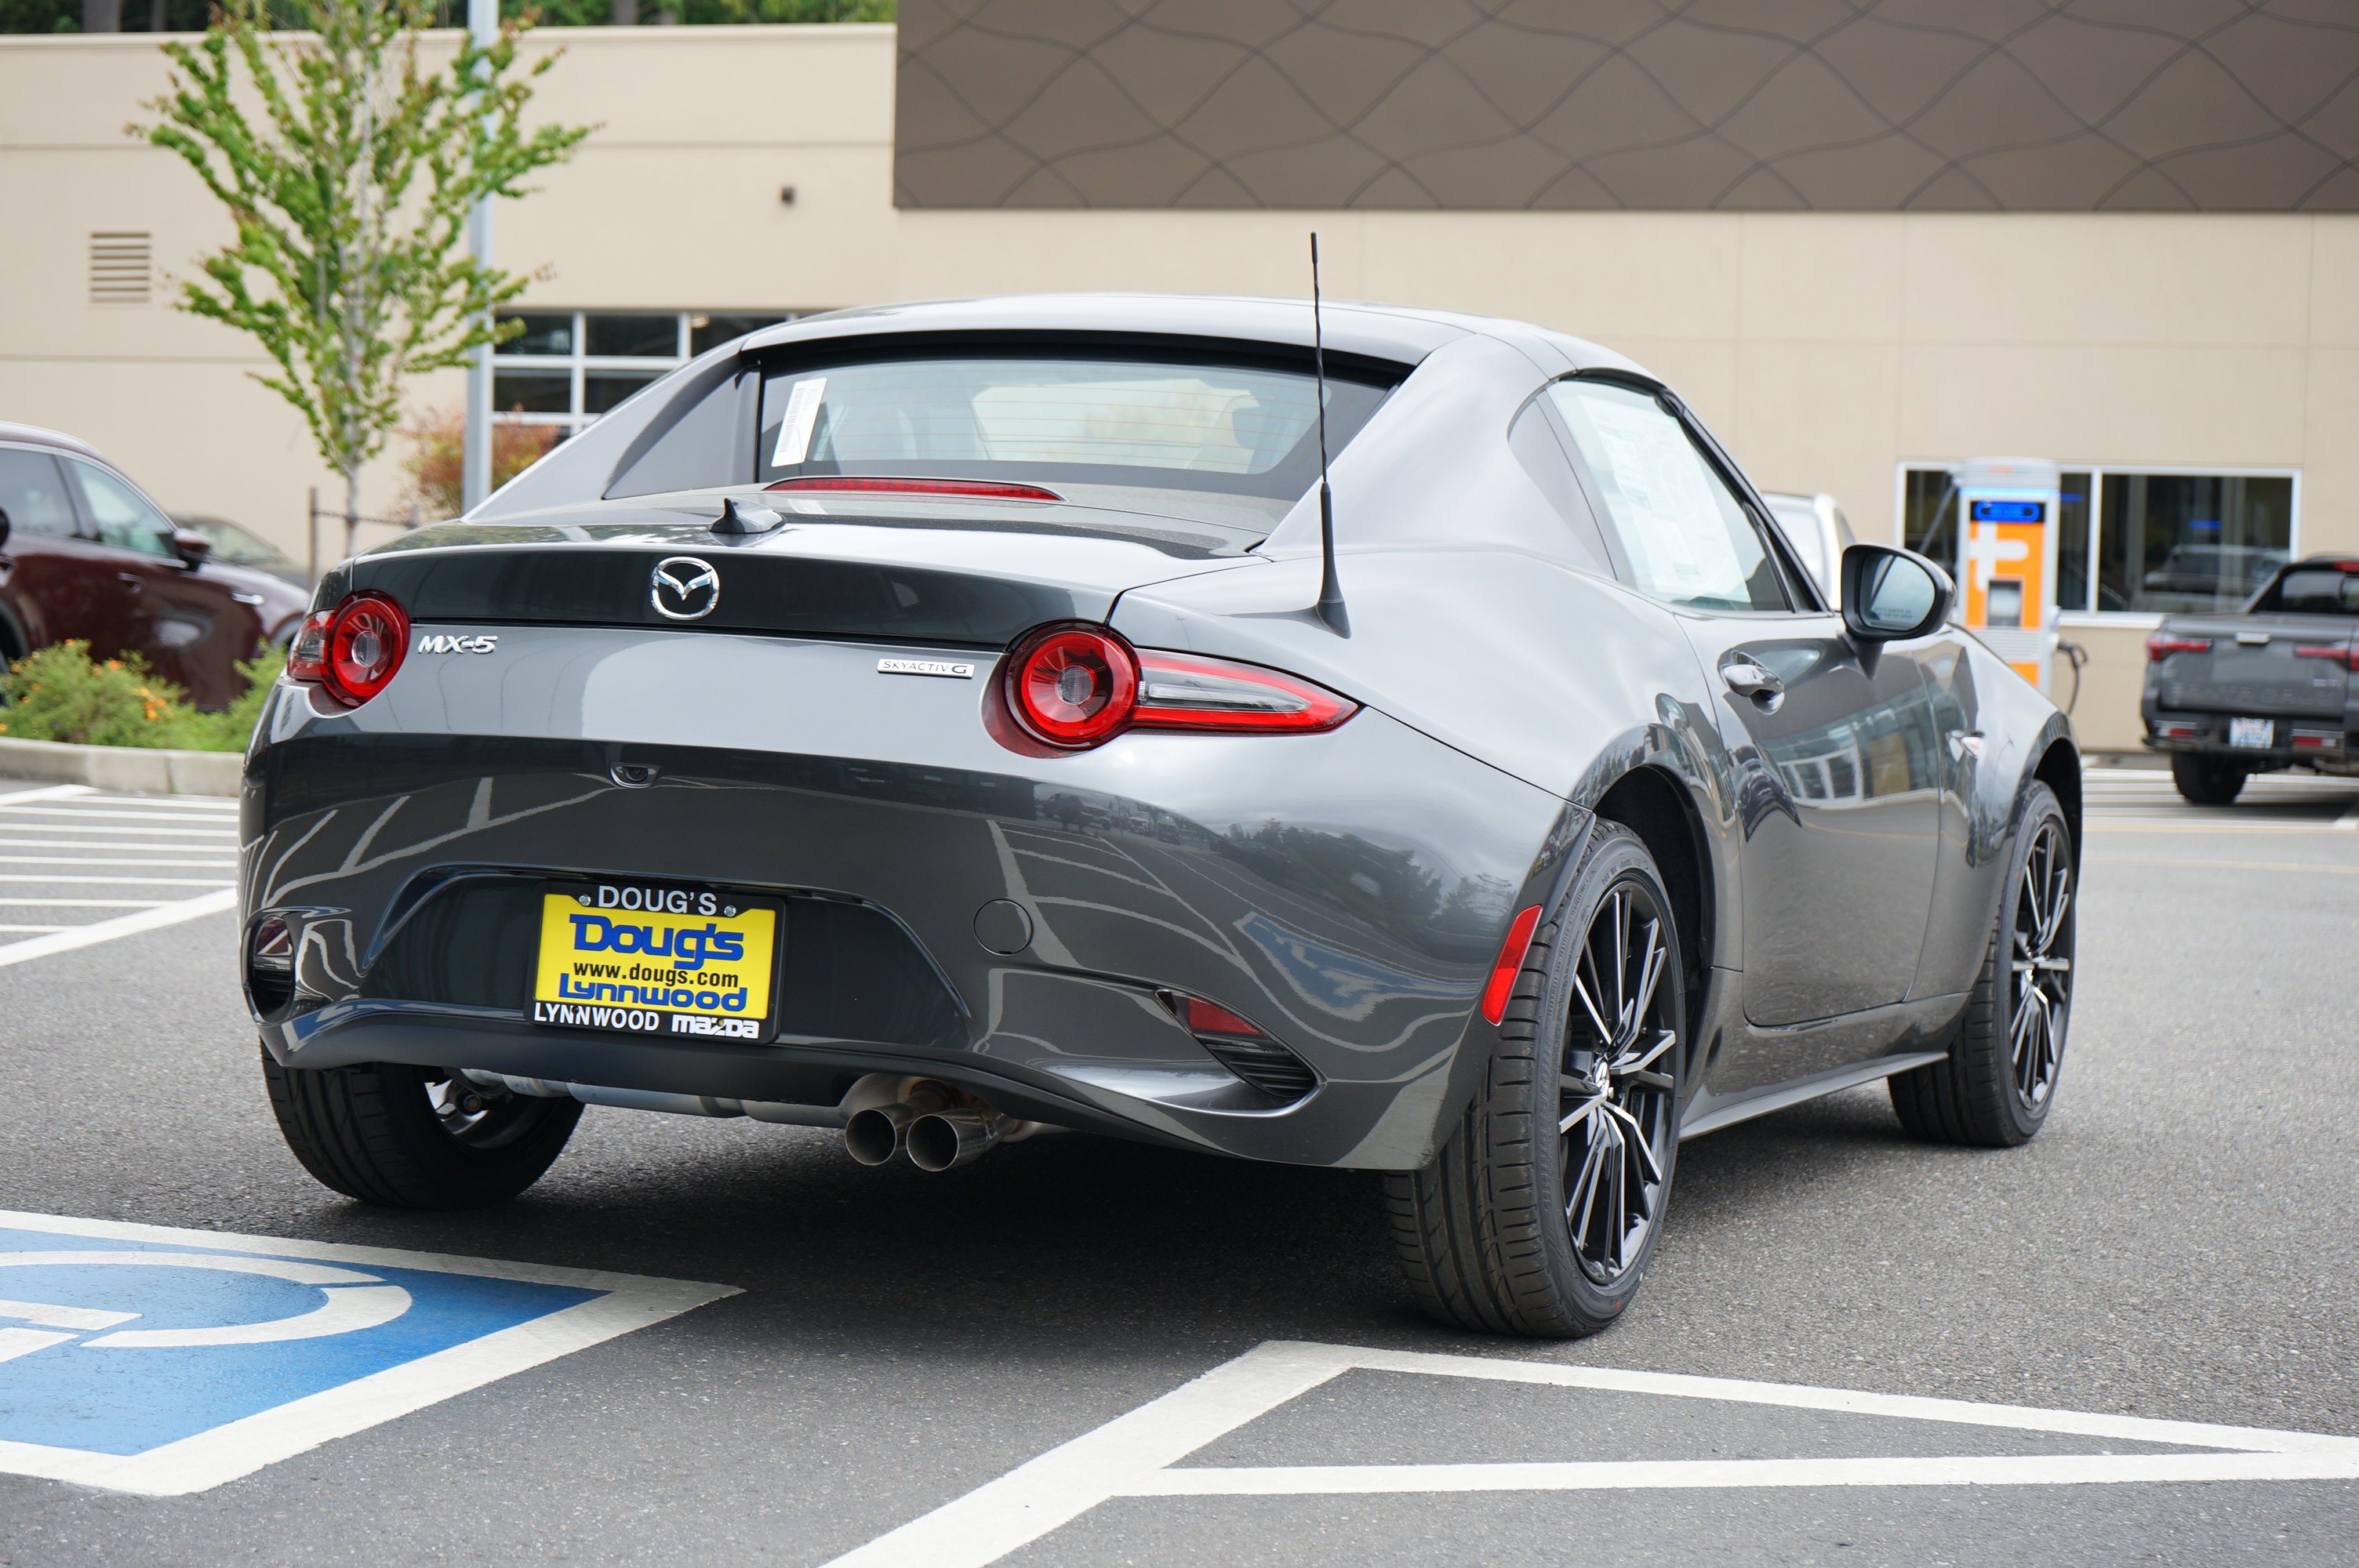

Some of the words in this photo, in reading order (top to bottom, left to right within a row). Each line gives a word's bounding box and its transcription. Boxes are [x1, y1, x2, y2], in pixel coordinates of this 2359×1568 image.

[417, 635, 498, 654] MX-5
[883, 661, 950, 672] SKYACTIV
[598, 885, 718, 916] DOUG'S
[569, 913, 744, 971] Doug's
[573, 962, 739, 988] www.dougs.com
[558, 972, 747, 1011] Lynnwood
[534, 1002, 660, 1031] LYNNWOOD
